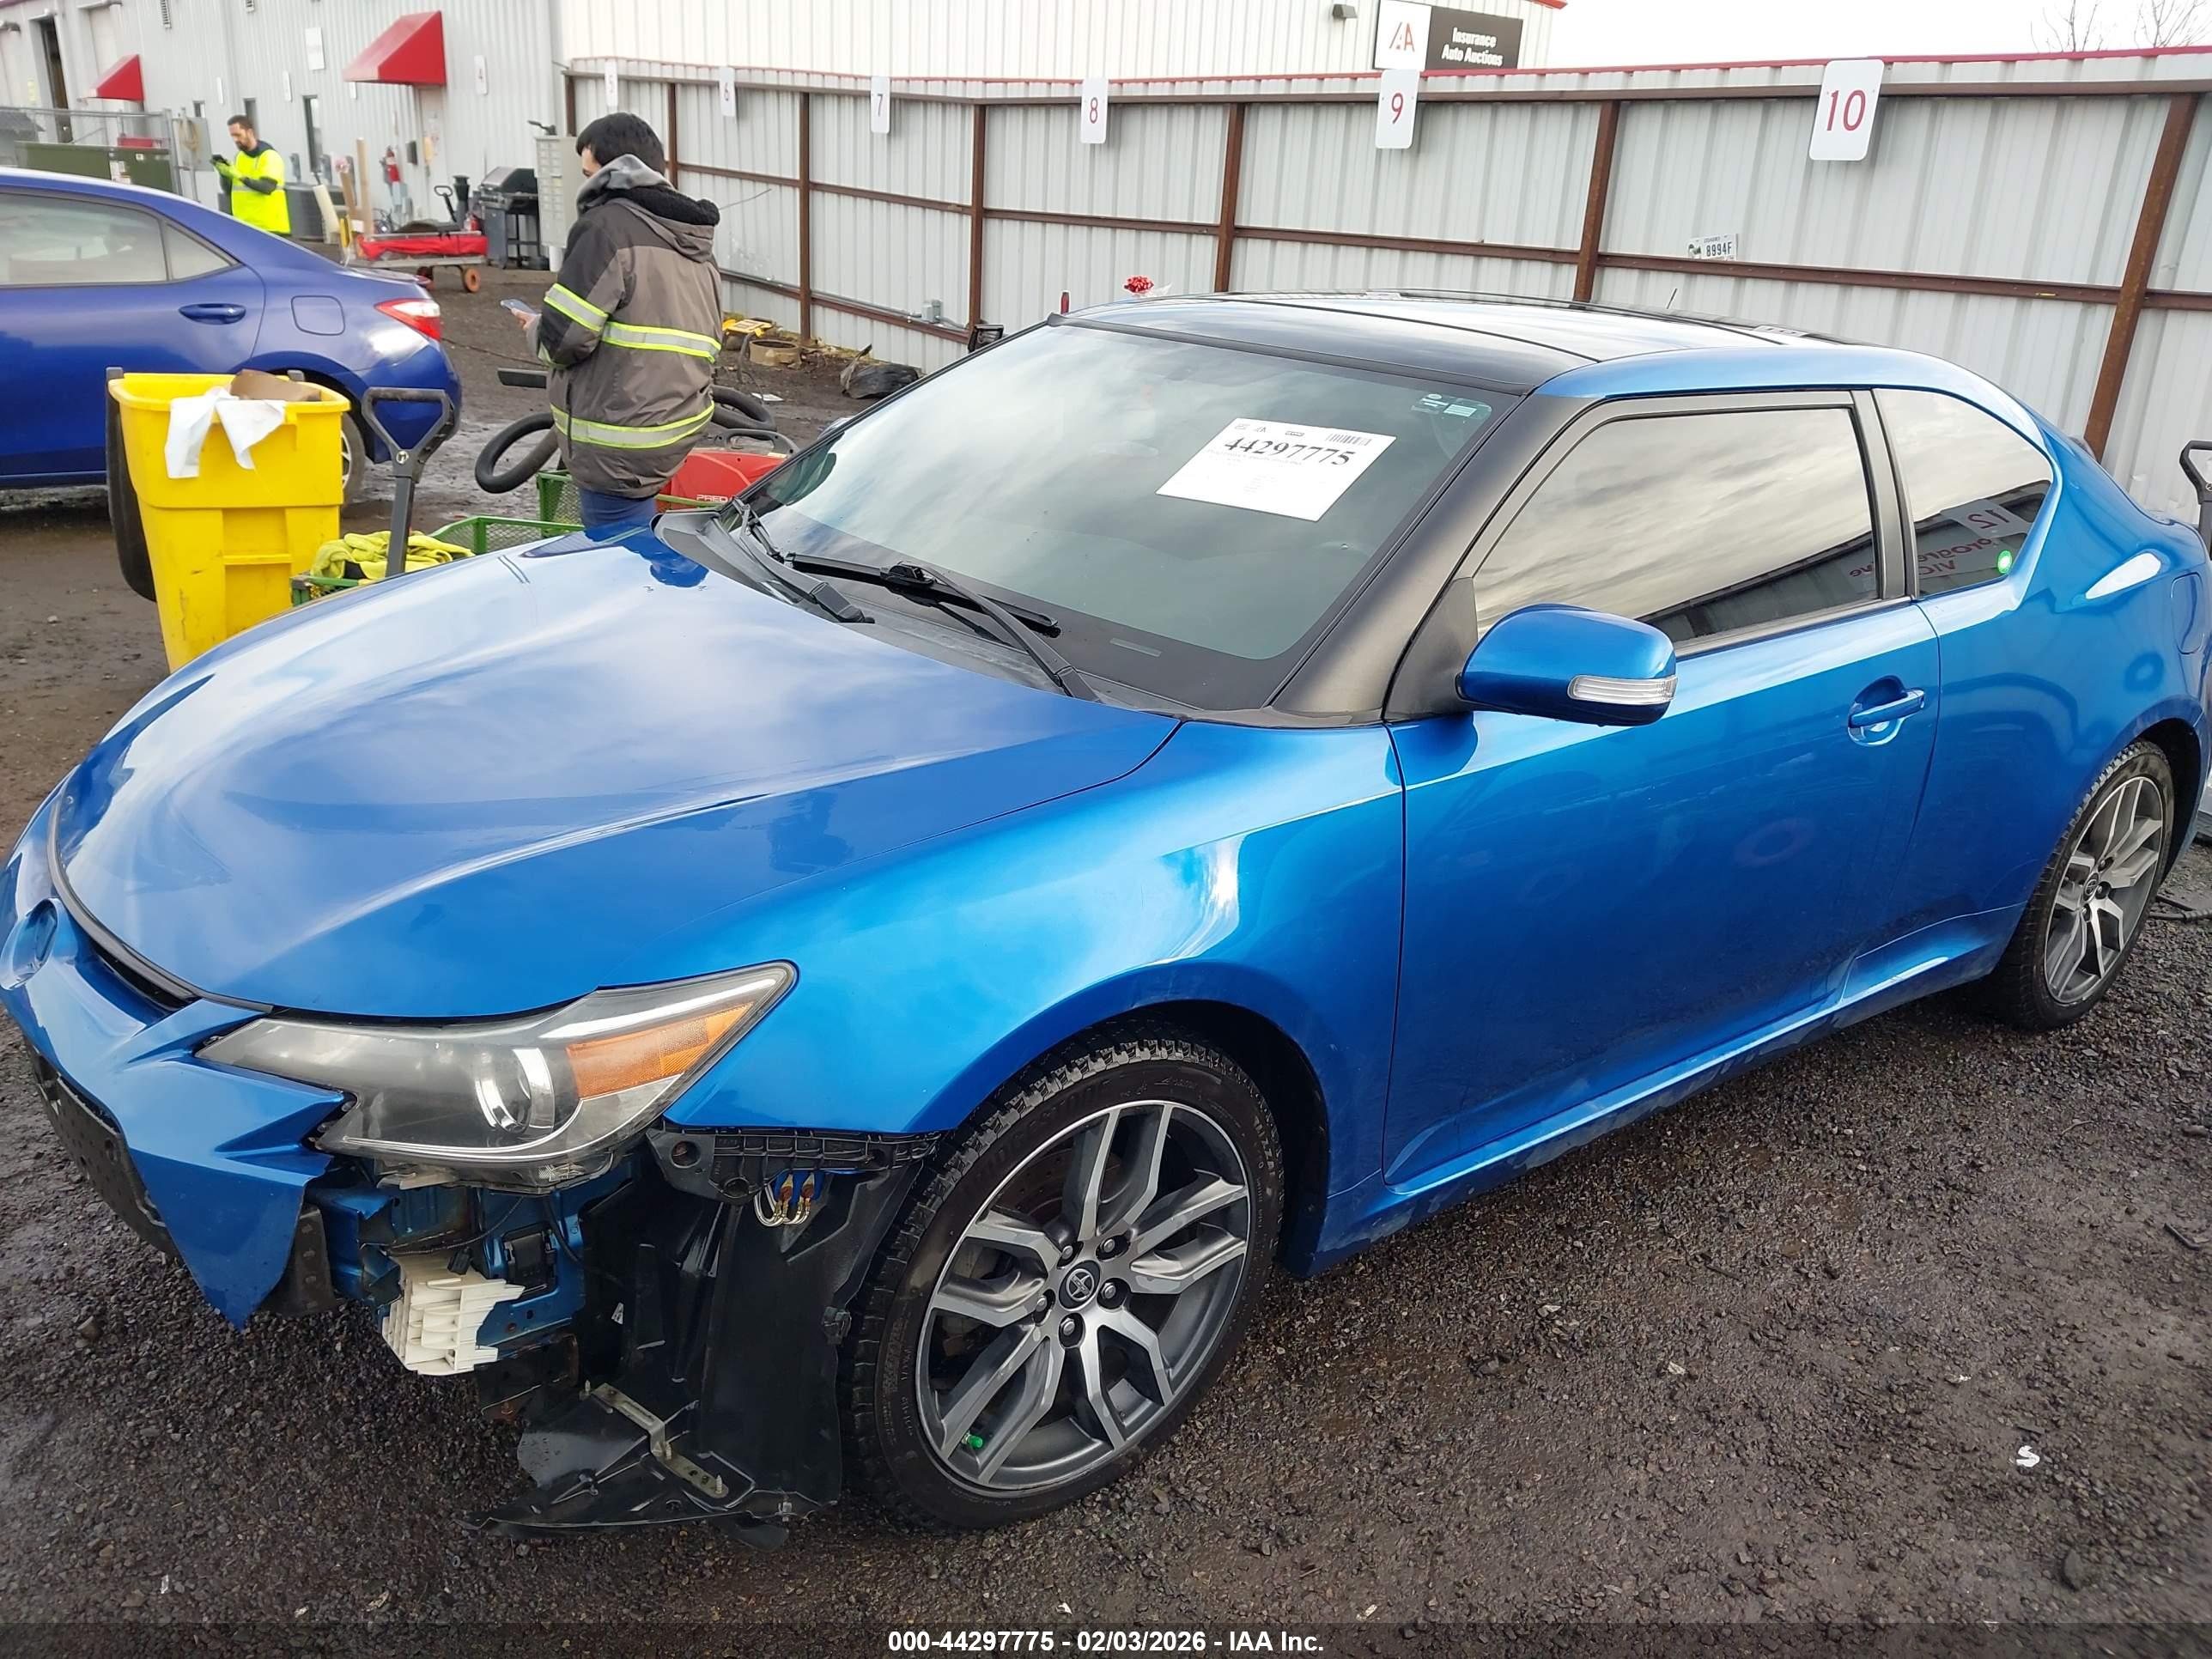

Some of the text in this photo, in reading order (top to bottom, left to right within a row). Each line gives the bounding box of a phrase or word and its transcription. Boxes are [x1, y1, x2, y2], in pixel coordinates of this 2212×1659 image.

[1452, 27, 1497, 48] Insurance
[1442, 44, 1504, 66] Auto Auctions
[877, 93, 884, 117] 7
[1089, 96, 1099, 124] 8
[1391, 92, 1404, 125] 9
[1826, 89, 1866, 131] 10
[1705, 241, 1732, 257] 8994F
[1224, 437, 1356, 465] 44297775
